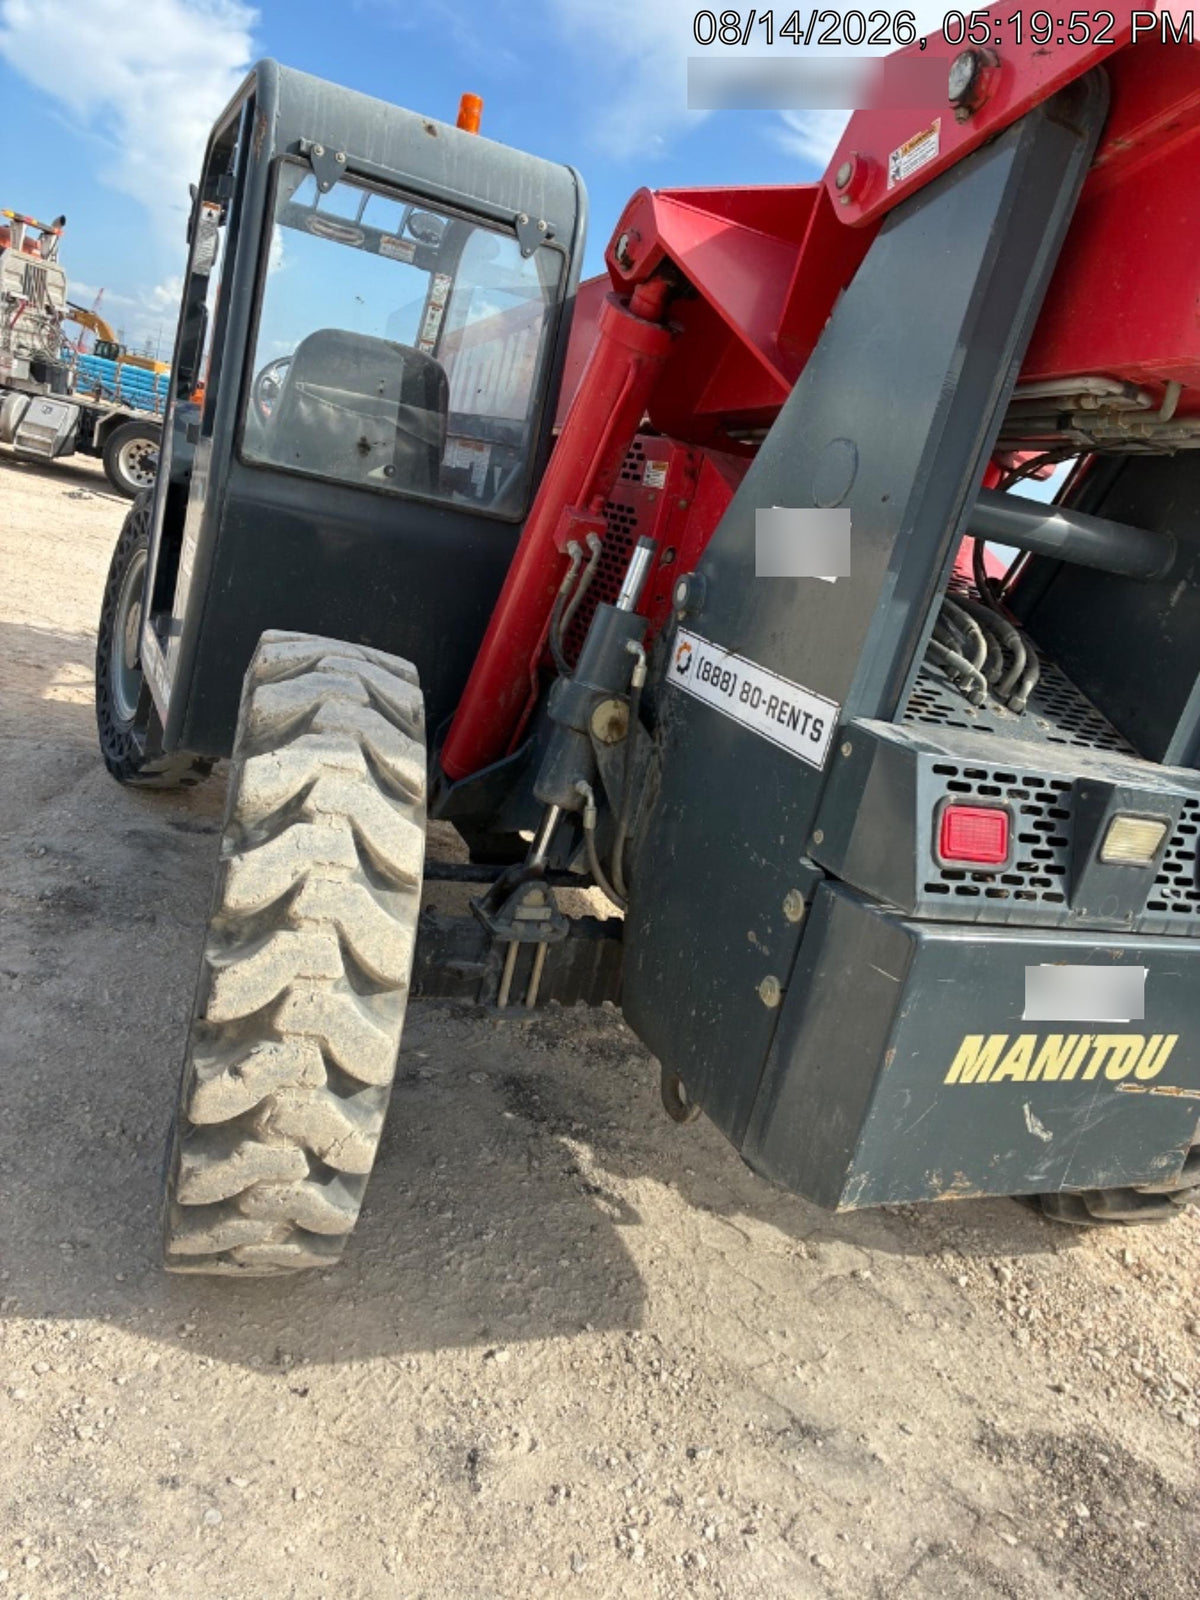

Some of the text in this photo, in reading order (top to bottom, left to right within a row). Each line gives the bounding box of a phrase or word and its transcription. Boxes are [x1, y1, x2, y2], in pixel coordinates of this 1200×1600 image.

[696, 656, 824, 743] (888) 80-RENTS
[943, 1033, 1180, 1085] MANITOU
